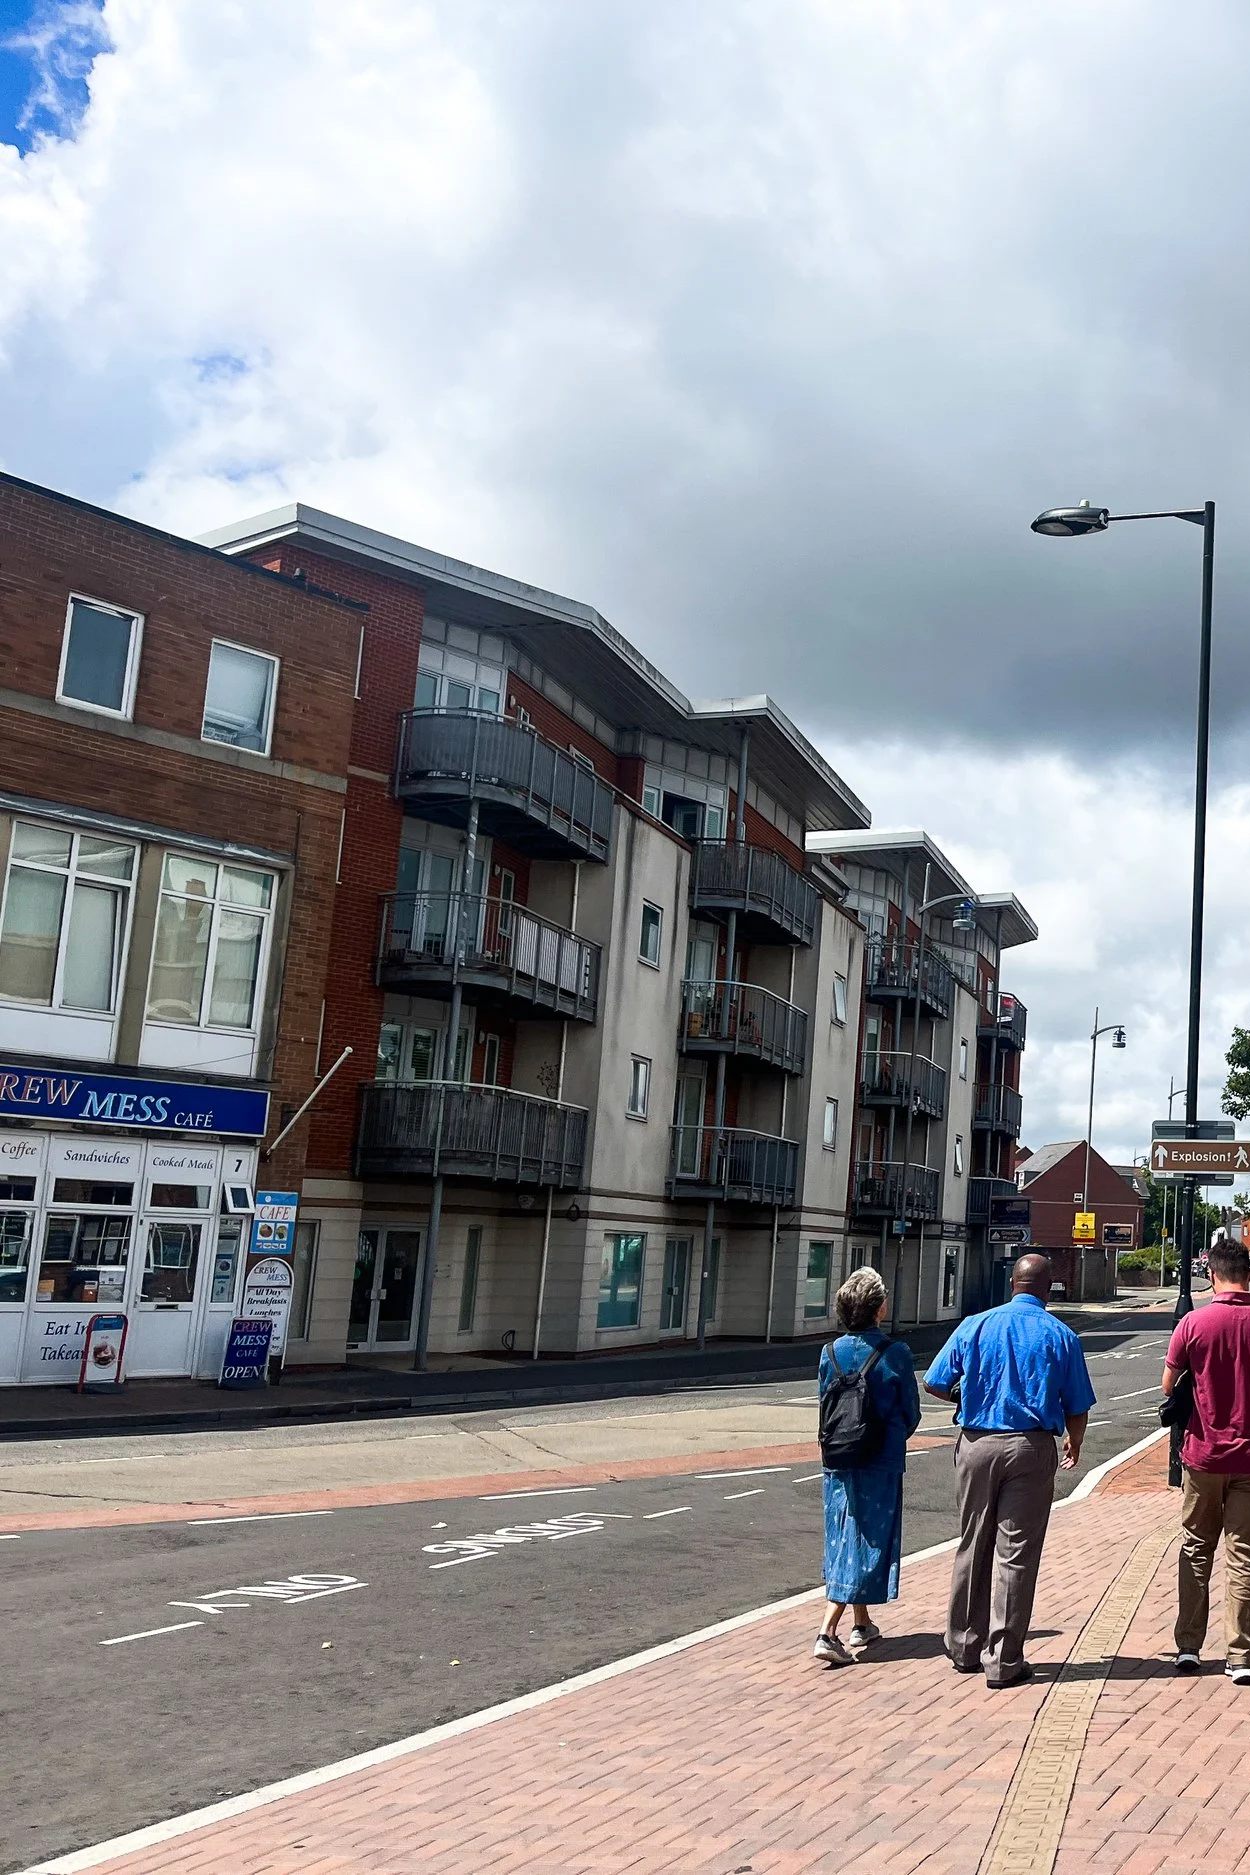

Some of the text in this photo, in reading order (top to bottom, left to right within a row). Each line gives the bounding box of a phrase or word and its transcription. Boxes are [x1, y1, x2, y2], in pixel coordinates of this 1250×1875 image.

[0, 1073, 214, 1128] REW MESS CAFÉ
[1, 1141, 37, 1160] Coffee
[64, 1149, 131, 1165] Sandwiches
[1171, 1150, 1231, 1163] Explosion!
[152, 1156, 214, 1170] Cooked Meals
[234, 1159, 243, 1173] 7
[260, 1205, 292, 1220] CAFE
[253, 1266, 279, 1275] CREW
[266, 1273, 288, 1281] MESS
[43, 1321, 71, 1336] Eat
[233, 1321, 272, 1332] CREW
[232, 1334, 269, 1346] MESS
[40, 1343, 84, 1361] Takea
[224, 1365, 264, 1379] OPEN
[167, 1511, 634, 1614] LOADING ONLY
